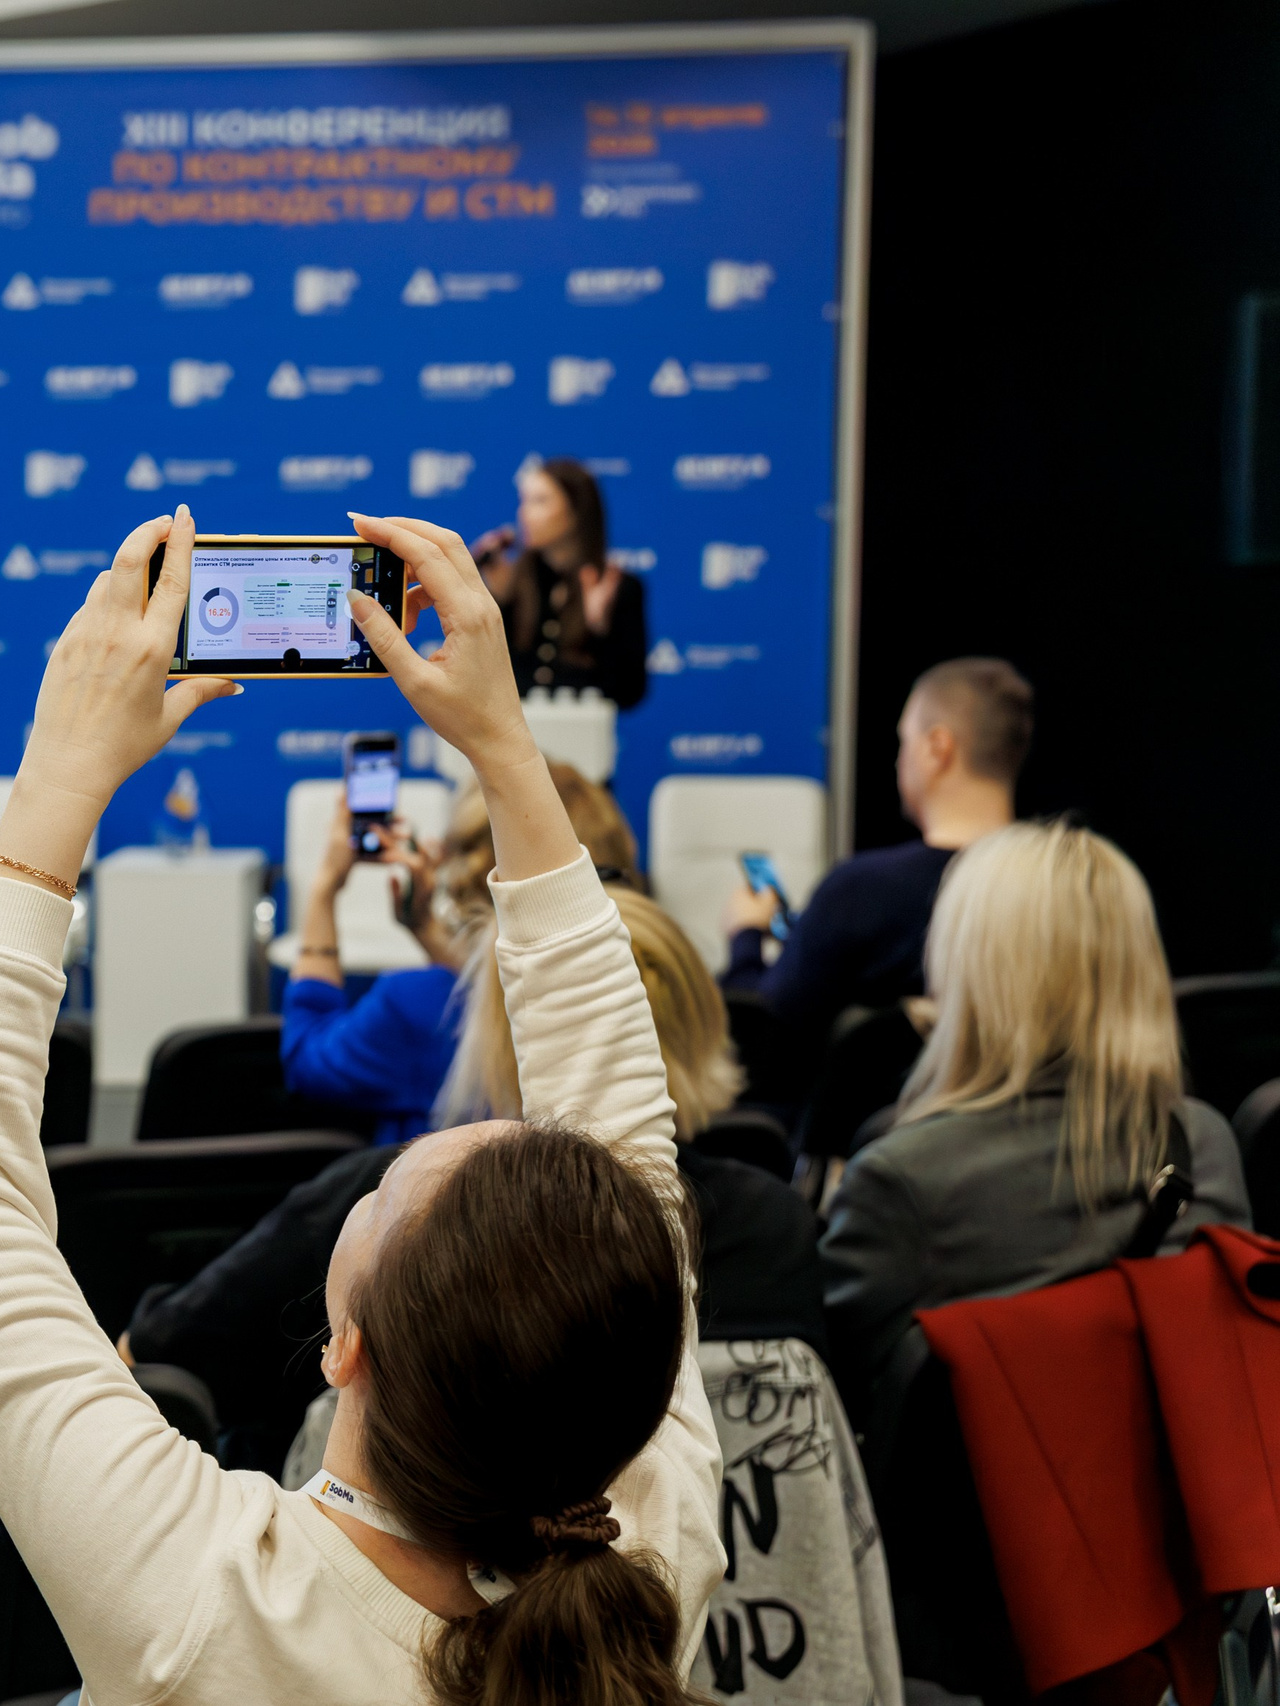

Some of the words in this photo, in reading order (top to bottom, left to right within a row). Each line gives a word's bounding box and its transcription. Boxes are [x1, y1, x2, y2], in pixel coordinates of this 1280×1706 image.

[197, 107, 509, 147] КОНФЕРЕНЦИЯ
[114, 152, 174, 184] ПО
[184, 147, 518, 183] КОНТРАКТНОМУ
[89, 188, 417, 224] ПРОИЗВОДСТВУ
[466, 185, 554, 219] СТМ
[329, 1482, 354, 1504] SobMa
